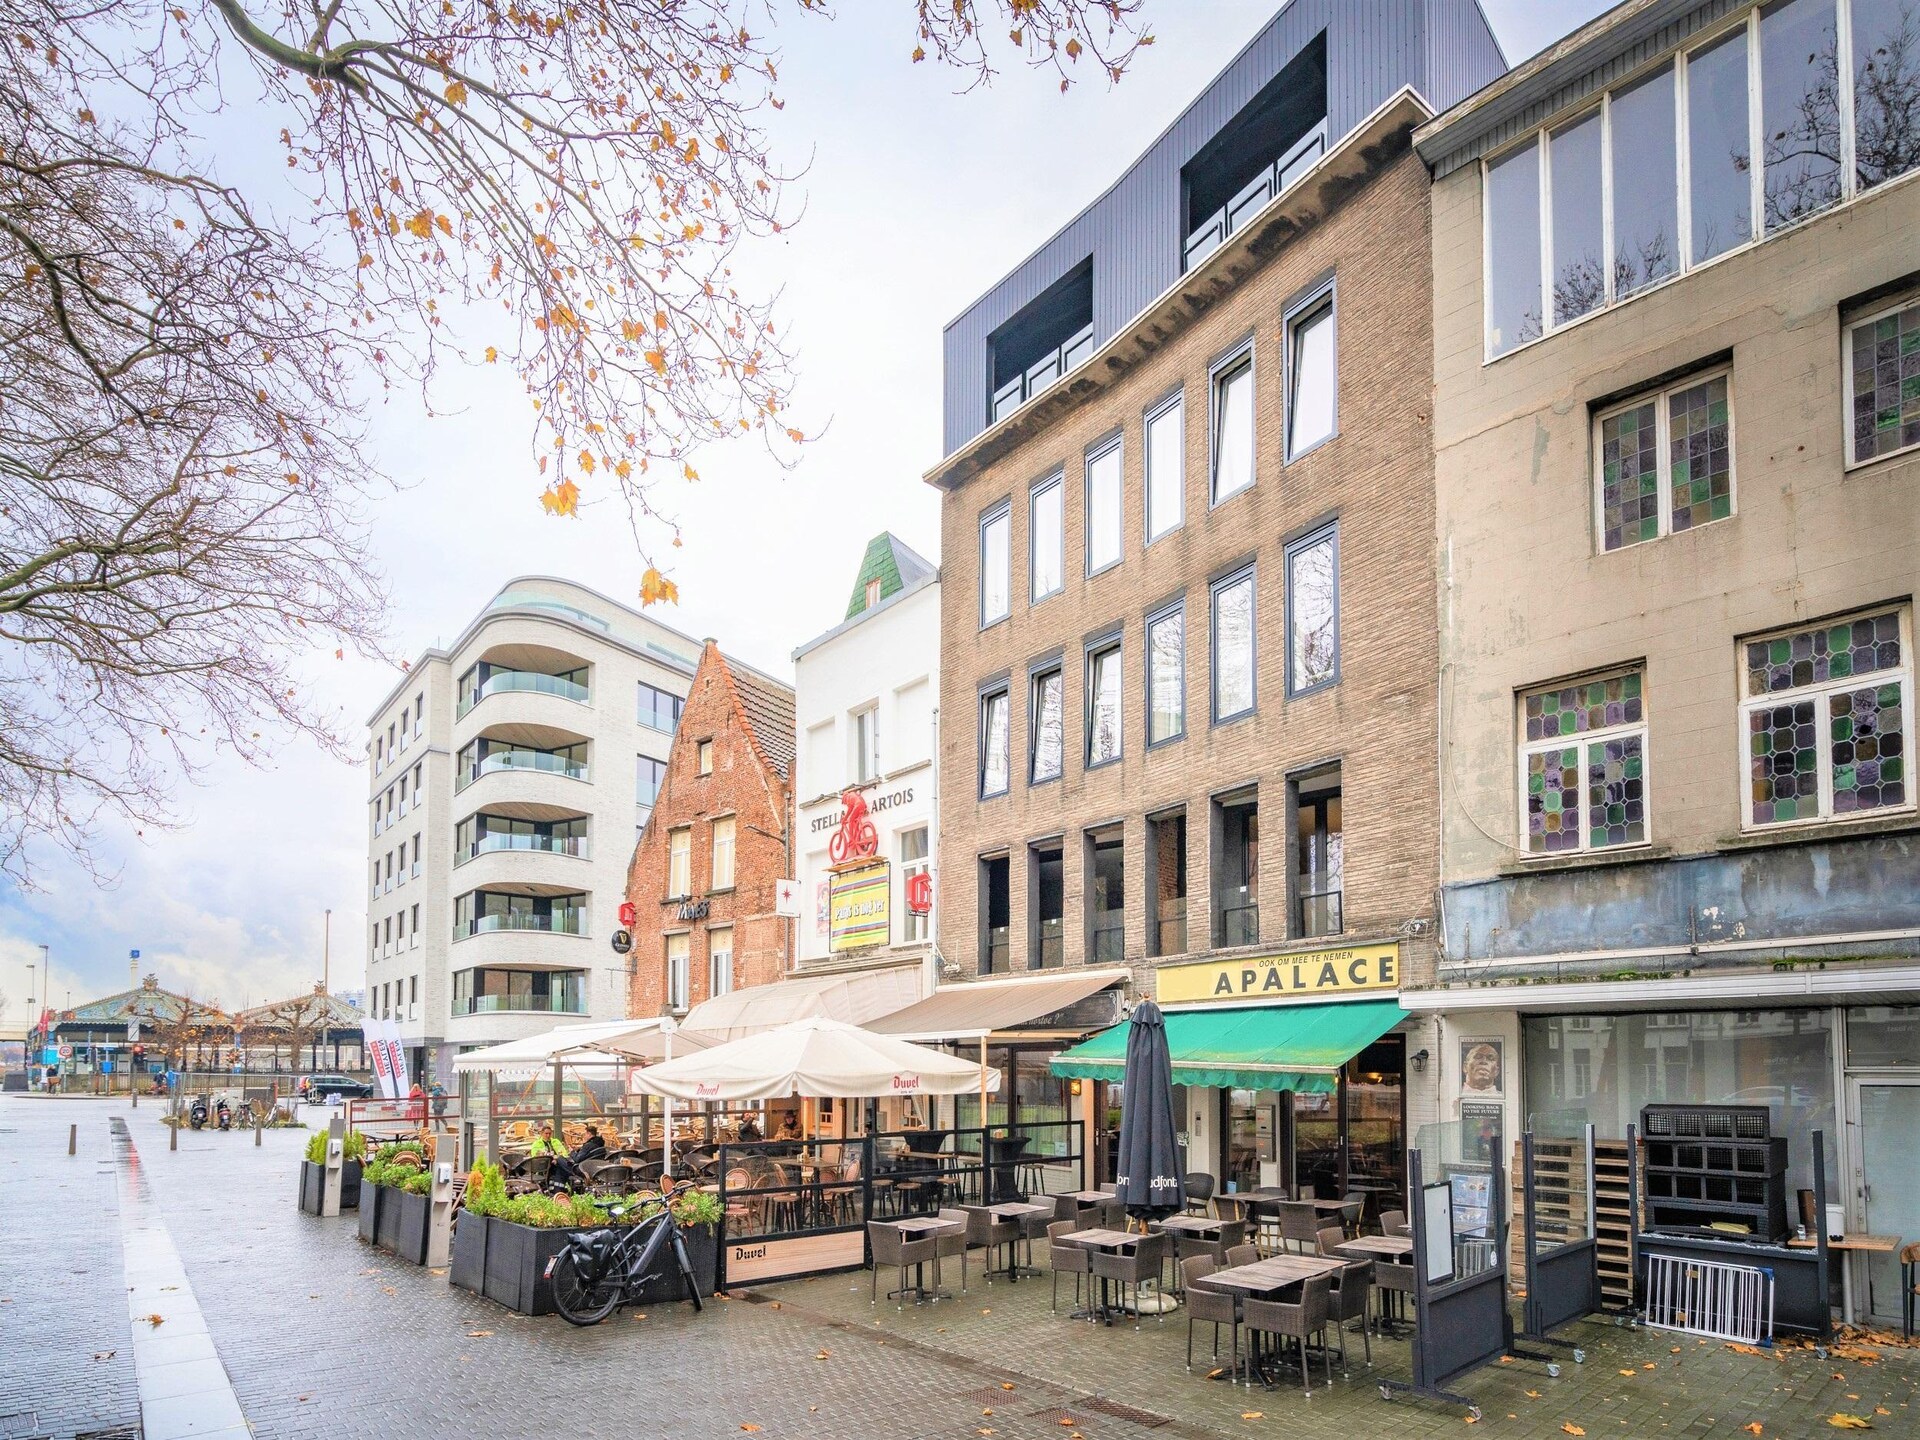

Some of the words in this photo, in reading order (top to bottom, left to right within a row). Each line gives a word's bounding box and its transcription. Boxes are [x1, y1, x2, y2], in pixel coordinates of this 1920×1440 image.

[871, 788, 914, 814] ARTOIS
[1259, 959, 1275, 968] OOK
[1277, 958, 1290, 966] OM
[1292, 956, 1308, 964] MEE
[1311, 955, 1321, 963] TE
[1323, 951, 1354, 962] NEMEN
[1214, 956, 1394, 995] APALACE
[696, 1083, 720, 1096] Duvel
[893, 1075, 920, 1089] Duvel
[735, 1244, 767, 1261] Duvel
